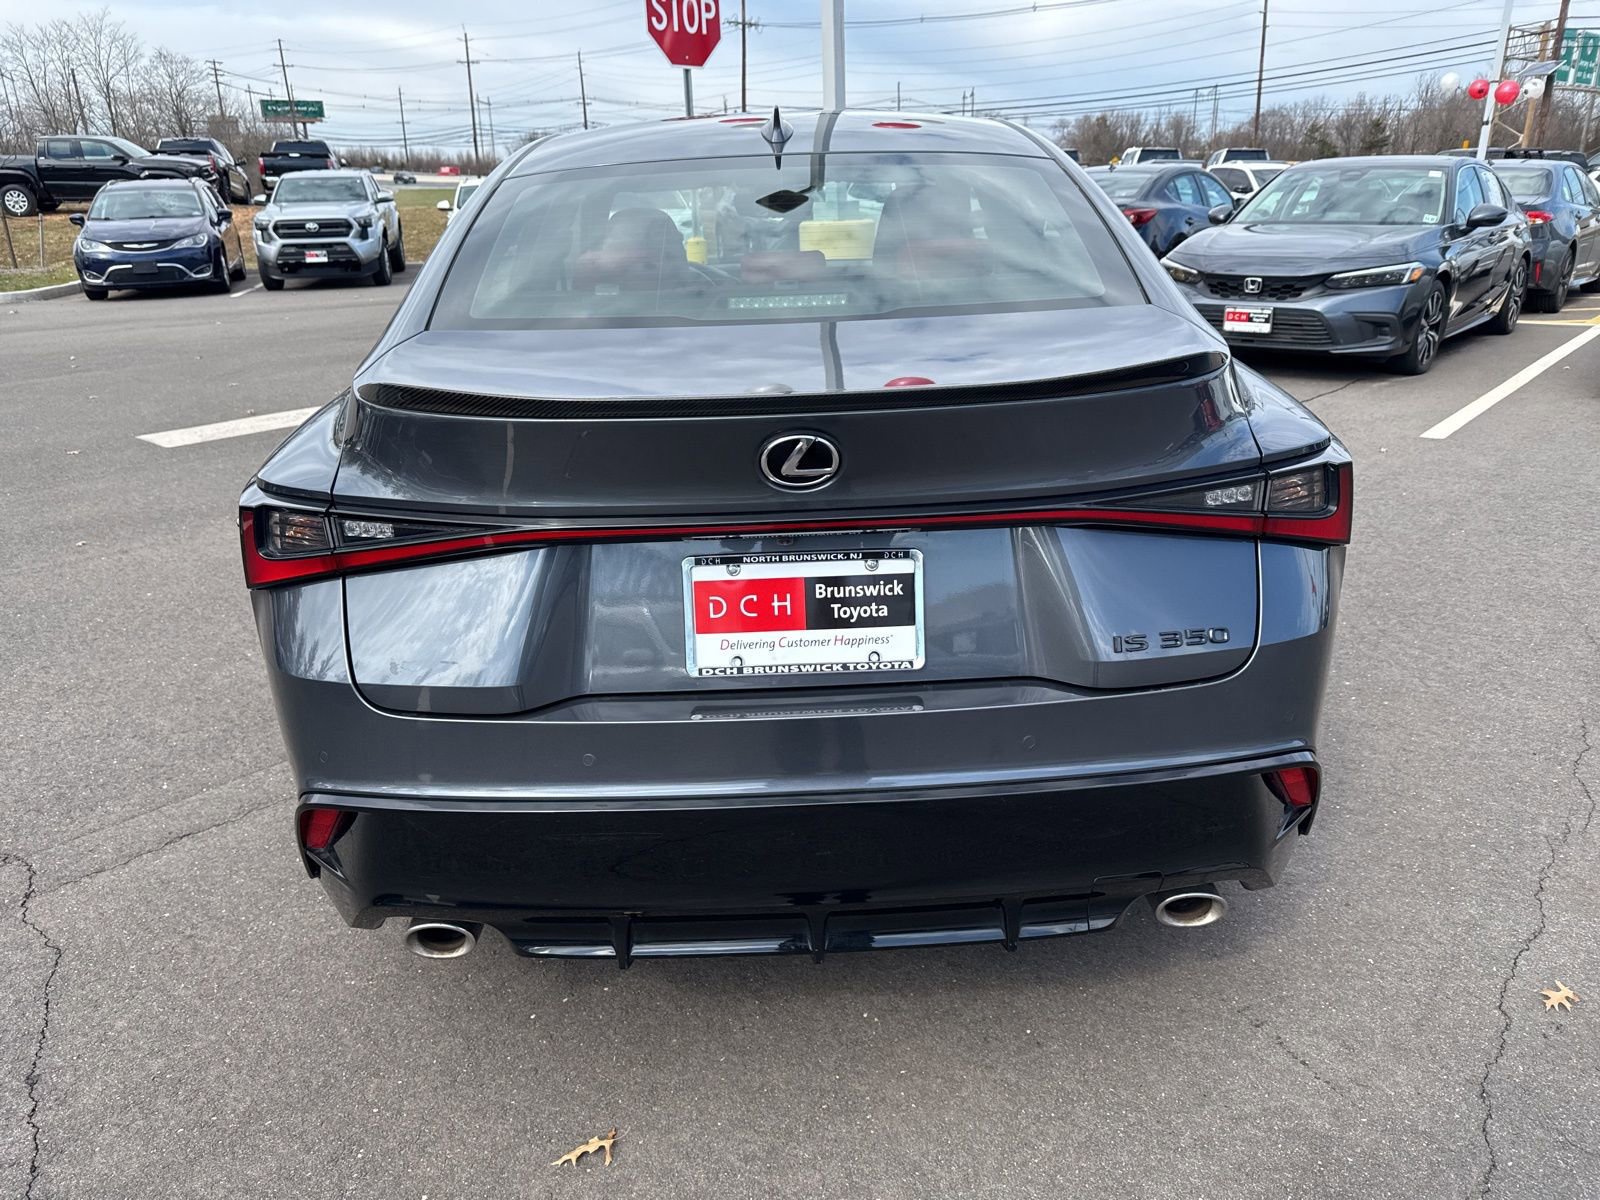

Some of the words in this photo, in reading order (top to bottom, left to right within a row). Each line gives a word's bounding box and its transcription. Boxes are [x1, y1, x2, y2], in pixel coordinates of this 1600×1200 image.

[651, 0, 716, 35] STOP
[743, 554, 780, 563] NORTH
[849, 552, 863, 560] NJ
[815, 580, 904, 599] Brunswick
[831, 602, 888, 623] Toyota
[720, 639, 776, 652] Delivering
[778, 636, 832, 649] Customer
[1113, 633, 1149, 654] IS
[1159, 627, 1230, 649] 350
[701, 667, 738, 677] DCH
[743, 662, 843, 675] BRUNSWICK
[847, 660, 912, 671] TOYOTA
